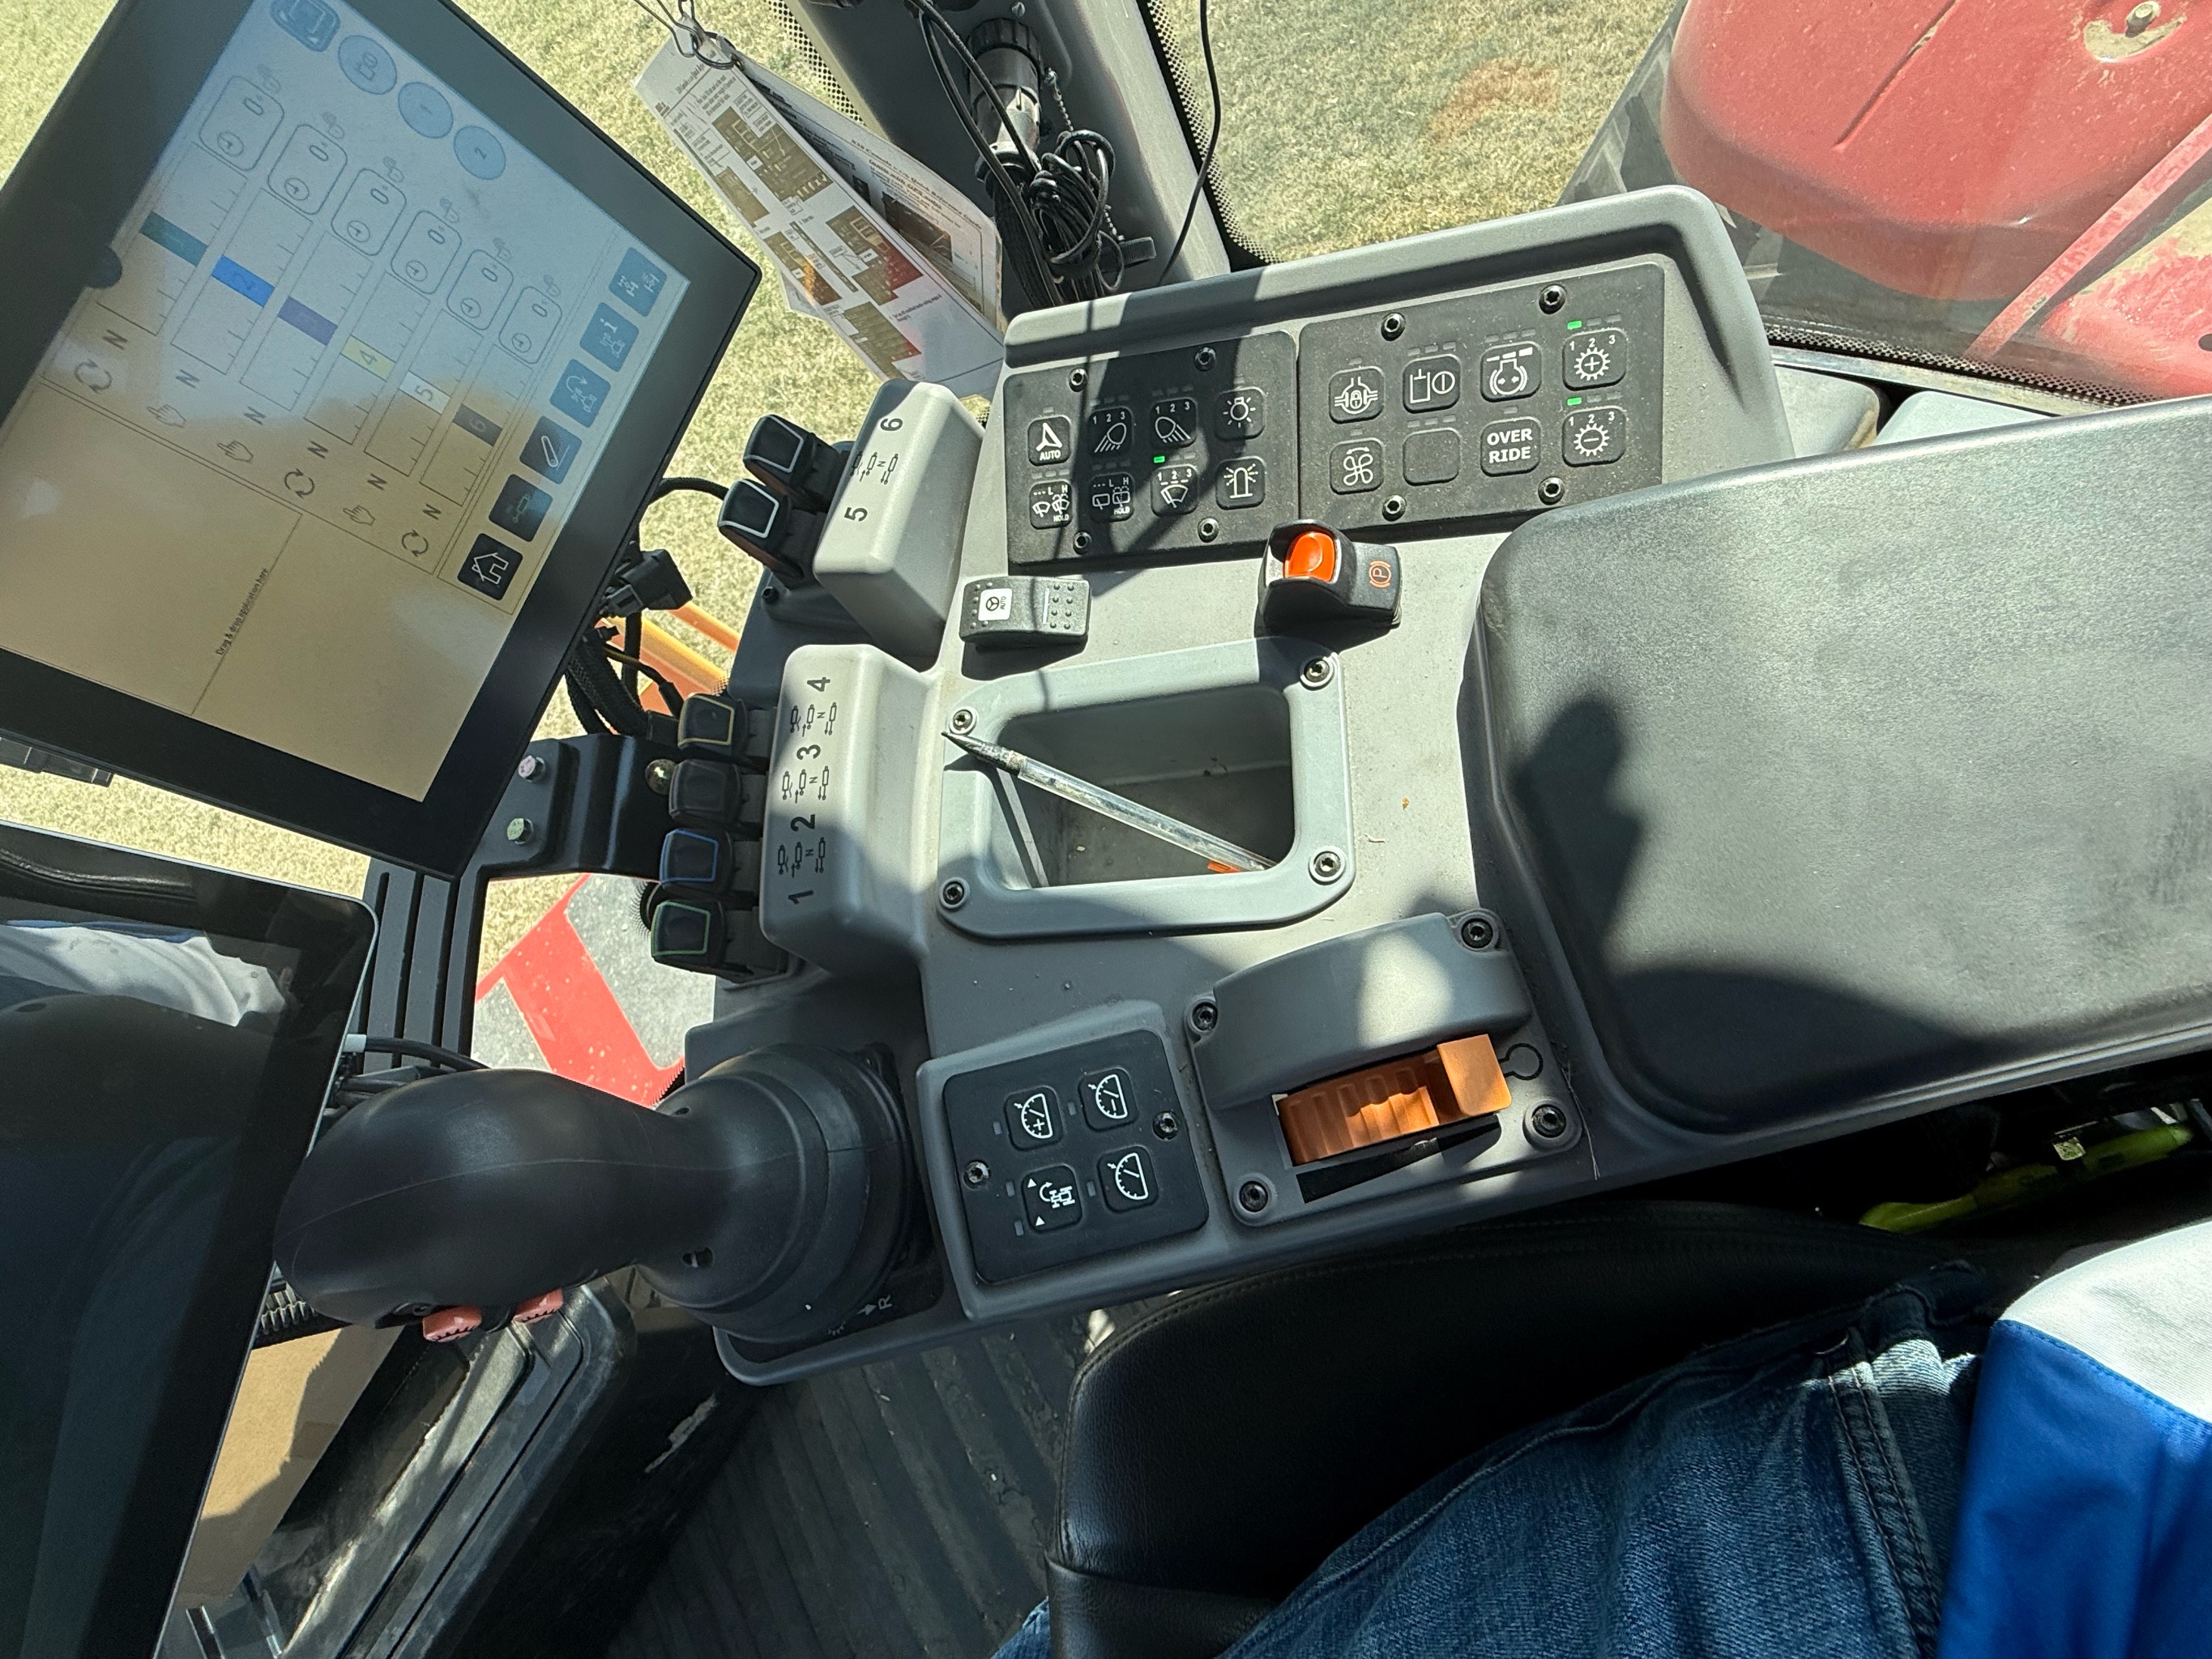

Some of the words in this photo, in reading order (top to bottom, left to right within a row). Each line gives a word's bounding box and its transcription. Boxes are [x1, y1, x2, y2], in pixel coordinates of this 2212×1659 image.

[474, 147, 487, 160] 2
[911, 174, 929, 192] Quick
[102, 329, 129, 351] N
[1569, 340, 1575, 351] 1
[1589, 338, 1595, 348] 2
[1608, 335, 1616, 345] 3
[359, 349, 378, 365] 4
[175, 369, 200, 389] N
[414, 382, 436, 403] 5
[244, 406, 267, 426] N
[1155, 406, 1160, 415] 1
[1170, 403, 1176, 413] 2
[1185, 401, 1190, 411] 3
[469, 417, 487, 433] 6
[880, 417, 903, 432] 6
[1093, 416, 1097, 424] 1
[1106, 414, 1112, 423] 2
[1120, 411, 1125, 420] 3
[1569, 416, 1574, 427] 1
[1588, 414, 1595, 424] 2
[1608, 412, 1615, 421] 3
[1487, 428, 1533, 446] OVER
[307, 441, 330, 459] N
[1039, 450, 1061, 461] AUTO
[1488, 446, 1531, 463] RIDE
[367, 473, 387, 491] N
[1108, 479, 1114, 488] L
[1123, 477, 1129, 485] H
[1158, 471, 1162, 481] 1
[1172, 471, 1177, 480] 2
[1186, 468, 1192, 478] 3
[1048, 486, 1054, 496] L
[1061, 484, 1068, 493] H
[423, 503, 442, 521] N
[843, 506, 869, 522] 5
[1053, 513, 1070, 522] HOLD
[1113, 506, 1130, 515] HOLD
[215, 639, 232, 655] Drag
[229, 617, 245, 633] drop
[238, 583, 260, 616] application
[255, 568, 269, 584] here
[807, 676, 831, 692] 4
[817, 711, 826, 719] N
[796, 744, 821, 760] 3
[809, 776, 818, 784] N
[790, 814, 816, 832] 2
[788, 889, 814, 904] 1
[878, 1294, 893, 1311] R
